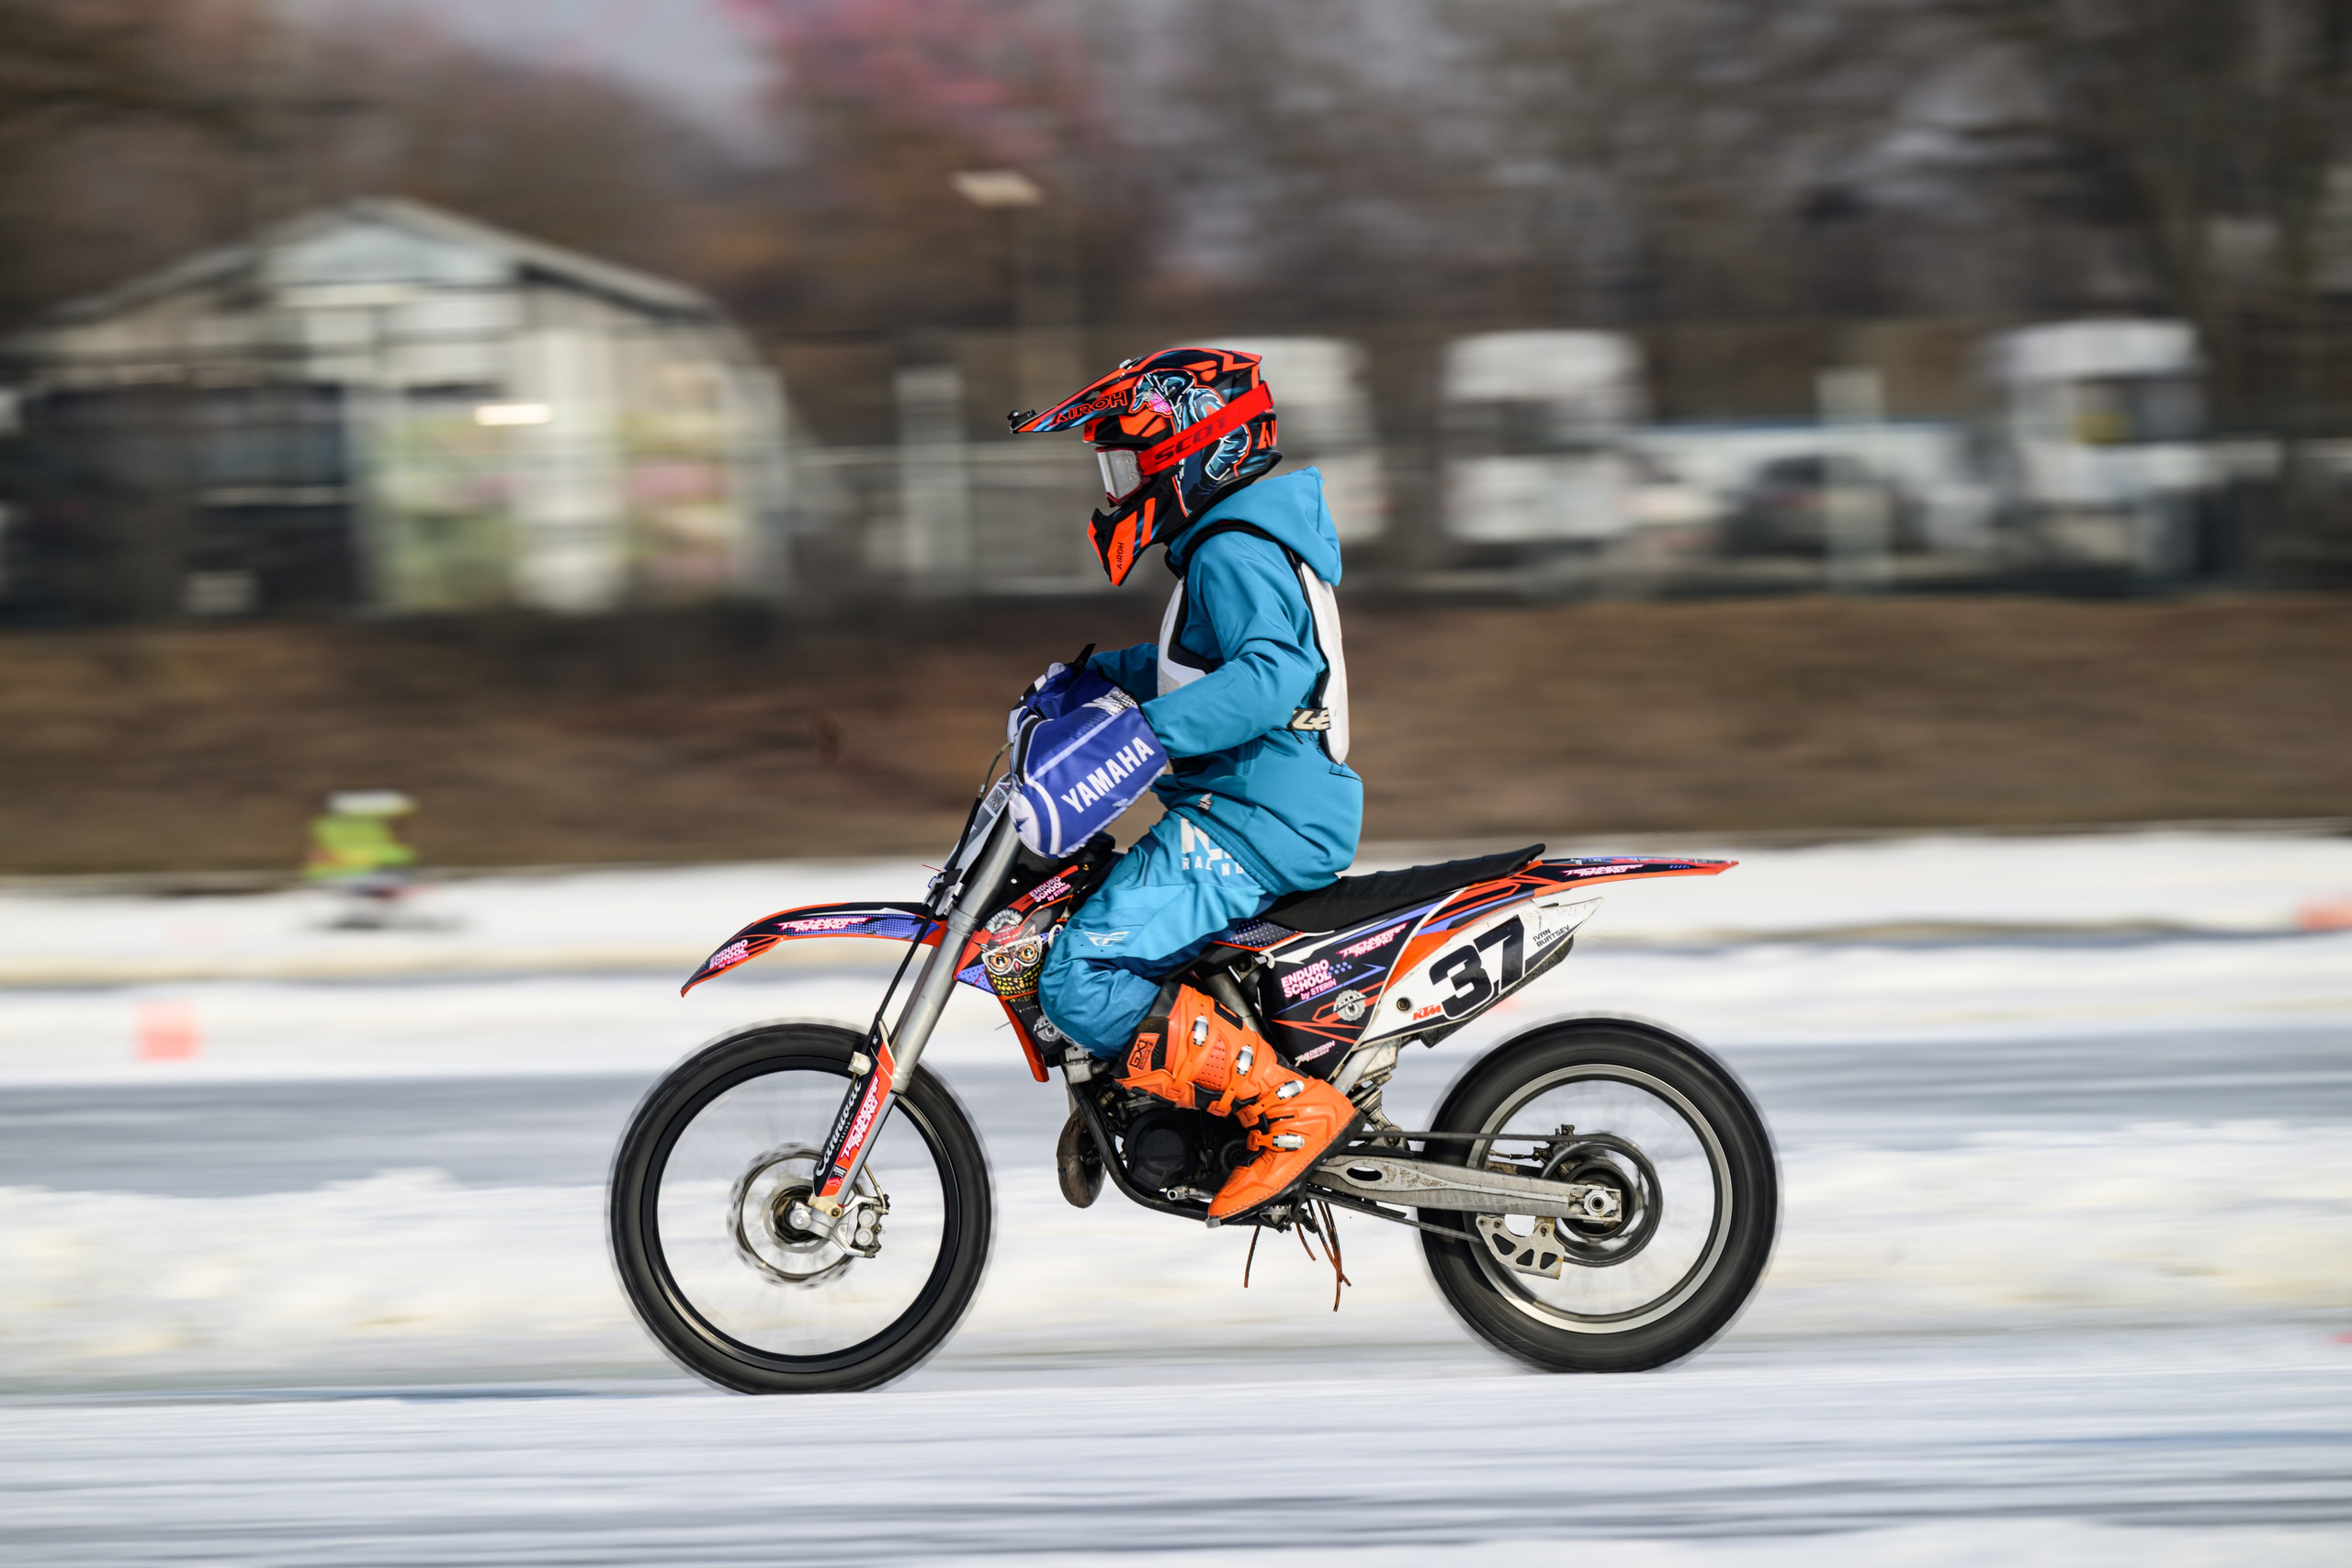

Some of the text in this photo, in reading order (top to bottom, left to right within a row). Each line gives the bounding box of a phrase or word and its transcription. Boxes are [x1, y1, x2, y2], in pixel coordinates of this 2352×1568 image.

[1048, 390, 1127, 427] AIROH
[1116, 542, 1125, 570] AIROH
[1060, 736, 1156, 814] YAMAHA
[1029, 875, 1061, 897] ENDURO
[1034, 881, 1066, 902] SCHOOL
[1053, 884, 1071, 897] STERIN
[1532, 928, 1551, 942] IVAN
[709, 947, 746, 969] SCHOOL
[710, 939, 748, 964] ENDURO
[727, 953, 749, 964] STERIN
[1281, 959, 1329, 988] ENDURO
[1430, 914, 1524, 1019] 37
[1283, 970, 1332, 998] SCHOOL
[1300, 992, 1310, 1000] by
[1310, 978, 1337, 996] STERIN
[1413, 1005, 1442, 1021] KTM
[840, 1122, 851, 1143] RACING
[855, 1099, 879, 1149] RACING
